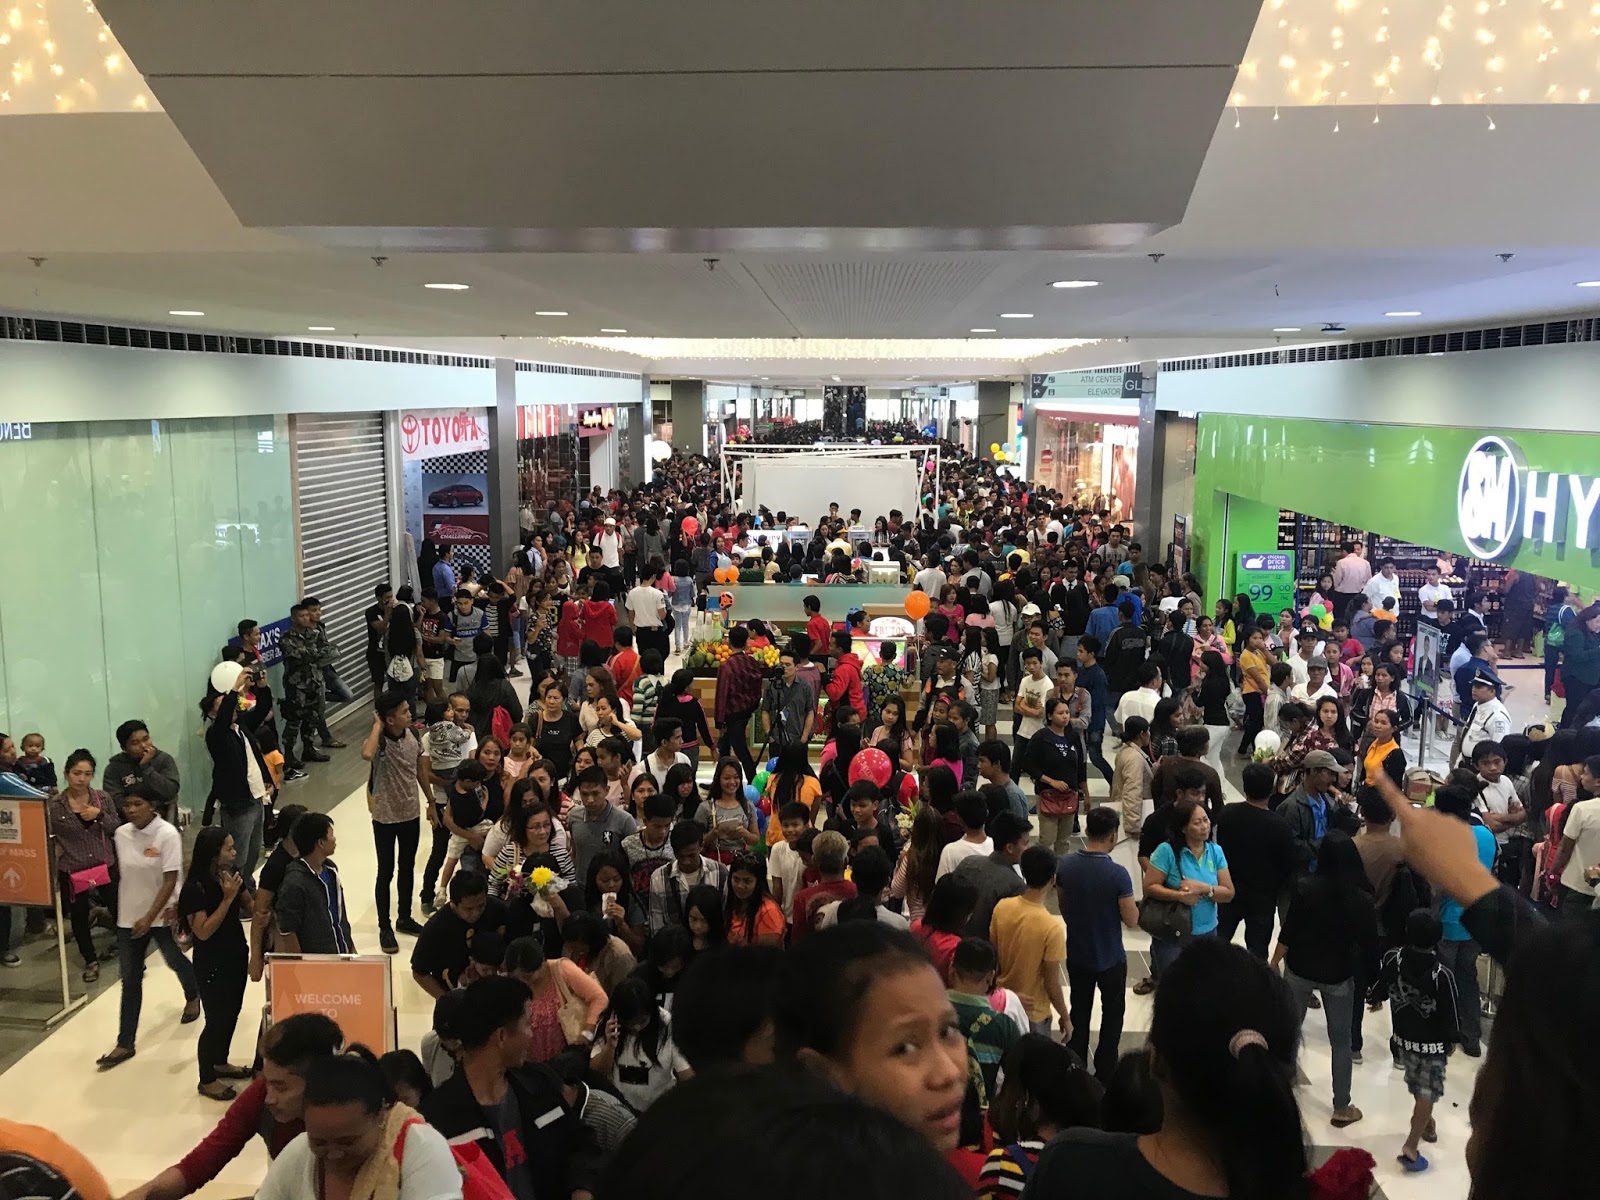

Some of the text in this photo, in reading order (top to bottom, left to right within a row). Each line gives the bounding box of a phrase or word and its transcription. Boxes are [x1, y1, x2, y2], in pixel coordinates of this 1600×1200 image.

[1033, 376, 1041, 384] L2
[1096, 375, 1122, 383] CENTER
[1125, 380, 1142, 390] GL
[1088, 388, 1121, 396] ELEVATOR
[421, 415, 479, 446] TOYOTA
[1460, 450, 1512, 543] SM
[1523, 471, 1600, 549] HY
[1249, 584, 1291, 602] 99 00
[875, 626, 906, 636] FRUTOS
[257, 627, 281, 651] AX'S
[9, 848, 37, 858] MASS
[294, 994, 362, 1005] WELCOME
[320, 1008, 338, 1019] TO
